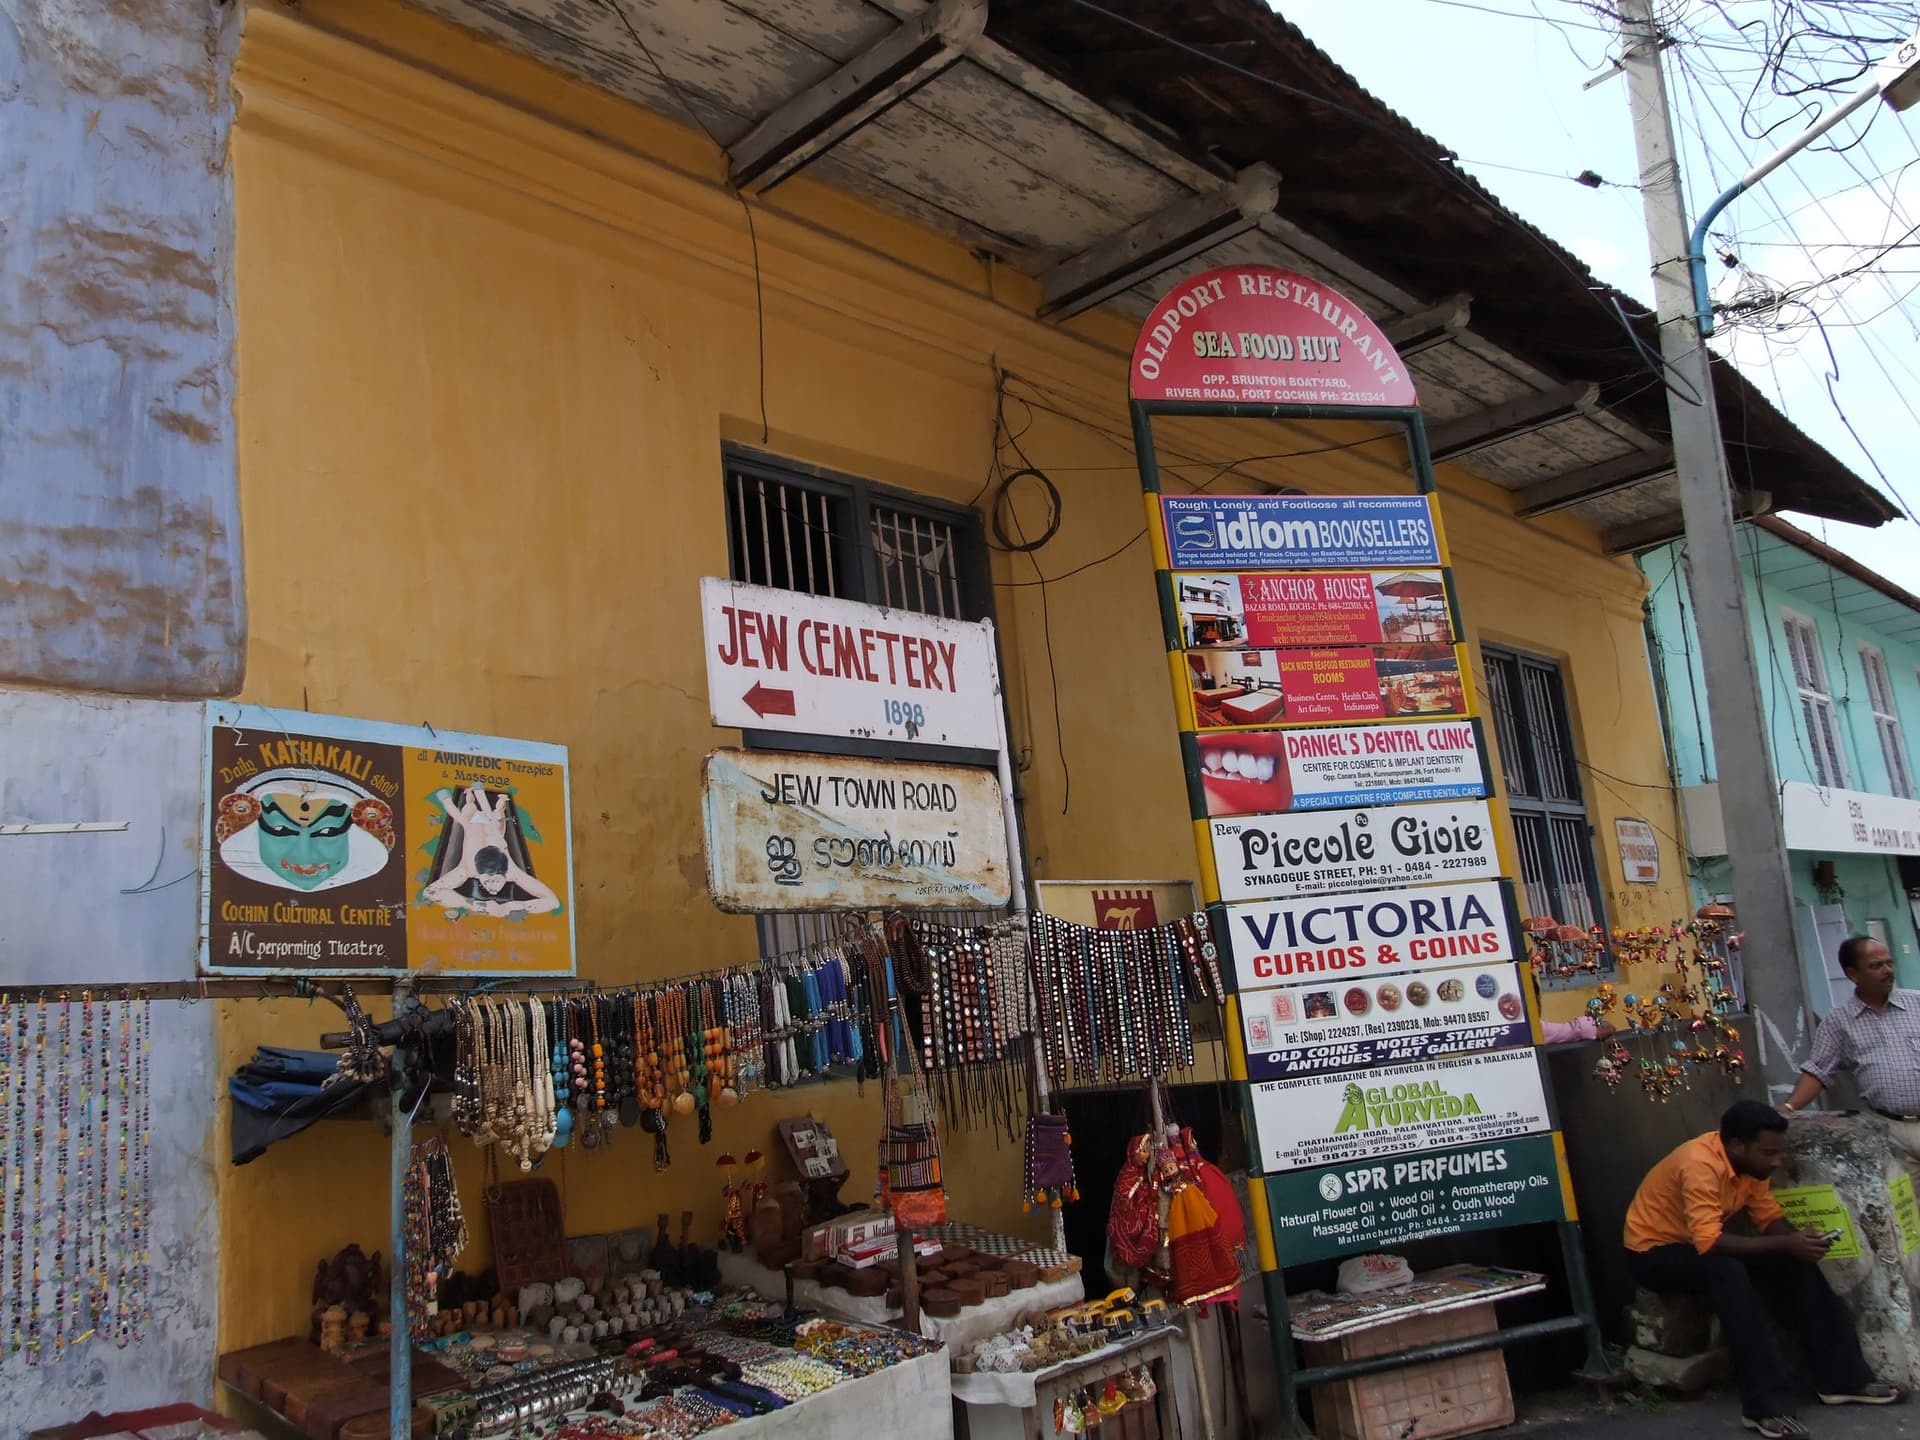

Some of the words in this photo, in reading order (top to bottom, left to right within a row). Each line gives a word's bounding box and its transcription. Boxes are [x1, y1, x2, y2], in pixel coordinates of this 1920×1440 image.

[1140, 278, 1226, 380] OLDPORT
[1237, 274, 1400, 385] RESTAURANT
[1192, 331, 1237, 359] SEA
[1240, 332, 1295, 361] FOOD
[1297, 335, 1341, 362] HUT
[1165, 388, 1201, 399] RIVER
[1204, 388, 1240, 400] ROAD,
[1242, 389, 1271, 400] FORT
[1274, 390, 1318, 401] COCHIN
[1321, 391, 1340, 401] PH:
[1202, 375, 1229, 385] OPP.
[1232, 375, 1287, 386] BRUNTON
[1289, 377, 1351, 389] BOATYARD,
[1258, 501, 1279, 509] and
[1282, 500, 1338, 509] Footloose
[1343, 500, 1356, 509] all
[1359, 499, 1422, 509] recommend
[1215, 511, 1320, 549] idiom
[1319, 519, 1429, 548] BOOKSELLERS
[1260, 578, 1318, 601] ANCHOR
[1323, 578, 1370, 600] HOUSE
[1244, 603, 1267, 612] BAZAR
[718, 606, 788, 672] JEW
[797, 619, 957, 693] CEMETERY
[1313, 672, 1345, 684] ROOMS
[1287, 693, 1315, 702] Business
[1341, 692, 1361, 701] Health
[1298, 705, 1308, 713] Art
[884, 699, 925, 727] 1898
[1287, 733, 1360, 759] DANIEL'S
[1363, 730, 1424, 754] DENTAL
[1427, 727, 1474, 751] CLINIC
[219, 757, 257, 783] Daily
[259, 740, 373, 781] KATHAKALI
[370, 774, 399, 798] show
[417, 751, 427, 761] all
[434, 751, 502, 770] AYURVEDIC
[506, 761, 553, 777] Therapies
[454, 769, 510, 787] Massage
[1302, 762, 1333, 772] CENTRE
[1334, 761, 1349, 770] FOR
[1350, 758, 1387, 769] COSMETIC
[1388, 758, 1393, 767] &
[1395, 756, 1424, 767] IMPLANT
[1427, 754, 1464, 765] DENTISTRY
[1435, 766, 1451, 774] Kochi
[761, 773, 822, 806] JEW
[828, 776, 896, 810] TOWN
[902, 781, 957, 812] ROAD
[1294, 799, 1299, 808] A
[1300, 796, 1344, 807] SPECIALITY
[1344, 794, 1375, 804] CENTRE
[1375, 792, 1391, 801] FOR
[1393, 789, 1432, 800] COMPLETE
[1433, 788, 1461, 798] DENTAL
[1462, 786, 1482, 796] CARE
[1214, 823, 1241, 836] New
[1239, 821, 1374, 870] Piccole
[1391, 815, 1482, 856] Gioie
[1244, 871, 1312, 886] SYNAGOGUE
[1314, 867, 1356, 880] STREET,
[1358, 866, 1377, 876] PH:
[1380, 864, 1393, 874] 91
[1405, 861, 1431, 872] 0484
[1442, 856, 1487, 869] 2227989
[1295, 882, 1326, 891] E-mail:
[221, 900, 269, 923] COCHIN
[273, 901, 335, 925] CULTURAL
[340, 904, 392, 927] CENTRE
[1241, 894, 1494, 950] VICTORIA
[228, 930, 255, 958] A/C
[256, 940, 322, 960] performing
[1253, 945, 1366, 978] CURIOS
[1377, 944, 1401, 964] &
[1409, 931, 1499, 961] COINS
[1284, 1032, 1299, 1044] Tel:
[1423, 1016, 1442, 1027] Mob:
[1443, 1013, 1466, 1026] 94470
[1467, 1010, 1490, 1023] 89567
[1268, 1050, 1302, 1062] OLD
[1307, 1043, 1358, 1058] COINS
[1376, 1035, 1429, 1050] NOTES
[1445, 1025, 1510, 1042] STAMPS
[1286, 1052, 1372, 1072] ANTIQUES
[1389, 1046, 1423, 1059] ART
[1427, 1037, 1497, 1054] GALLERY
[1260, 1083, 1275, 1092] THE
[1277, 1077, 1322, 1090] COMPLETE
[1323, 1071, 1367, 1084] MAGAZINE
[1369, 1069, 1382, 1078] ON
[1384, 1064, 1425, 1076] AYURVEDA
[1426, 1063, 1436, 1071] IN
[1437, 1057, 1473, 1070] ENGLISH
[1474, 1057, 1482, 1065] &
[1483, 1050, 1533, 1064] MALAYALAM
[1365, 1079, 1448, 1105] GLOBAL
[1333, 1093, 1482, 1135] AYURVEDA
[1275, 1148, 1302, 1159] E-mail:
[1426, 1127, 1457, 1137] Website:
[1297, 1133, 1359, 1148] CHATHANGAT
[1467, 1114, 1497, 1123] KOCHI
[1291, 1156, 1317, 1166] Tel:
[1321, 1148, 1367, 1161] 98473
[1344, 1165, 1388, 1194] SPR
[1394, 1149, 1507, 1186] PERFUMES
[1280, 1211, 1320, 1228] Natural
[1322, 1206, 1357, 1220] Flower
[1359, 1200, 1375, 1213] Oil
[1390, 1193, 1417, 1208] Wood
[1420, 1189, 1435, 1201] Oil
[1451, 1180, 1526, 1197] Aromatherapy
[1528, 1175, 1549, 1187] Oils
[1312, 1221, 1359, 1238] Massage
[1361, 1215, 1376, 1228] Oil
[1391, 1207, 1418, 1222] Oudh
[1420, 1203, 1435, 1215] Oil
[1452, 1198, 1481, 1211] Oudh
[1484, 1192, 1515, 1207] Wood
[1338, 1225, 1407, 1245] Mattancherry,
[1408, 1220, 1424, 1231] Ph:
[1460, 1209, 1503, 1222] 2222661
[1379, 1225, 1460, 1246] www.sprfragrance.com
